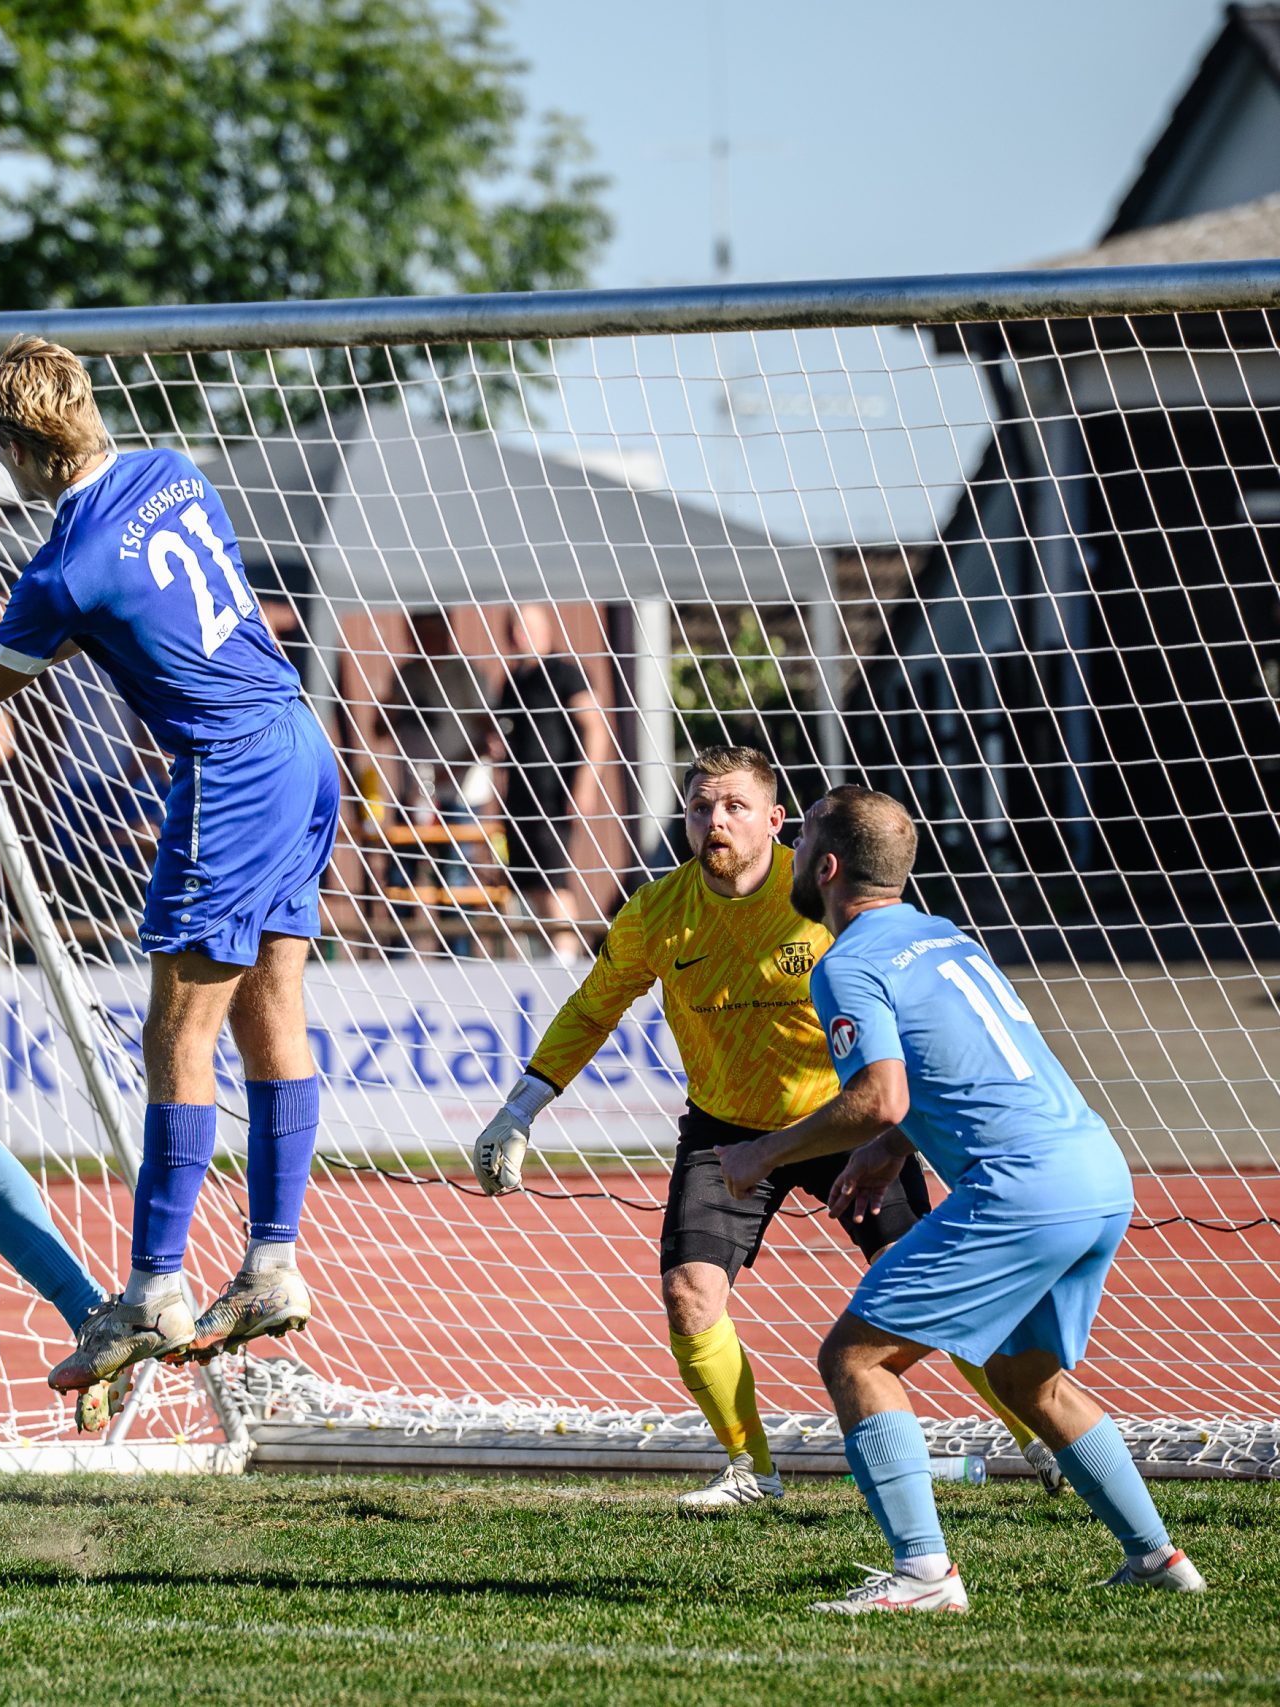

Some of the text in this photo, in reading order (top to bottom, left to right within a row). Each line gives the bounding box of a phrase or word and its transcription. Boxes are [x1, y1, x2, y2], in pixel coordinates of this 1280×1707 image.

[120, 478, 205, 560] TSG GIENGEN
[148, 502, 255, 660] 21
[238, 601, 252, 613] TSG
[215, 624, 230, 640] TSG
[891, 949, 917, 970] SGM
